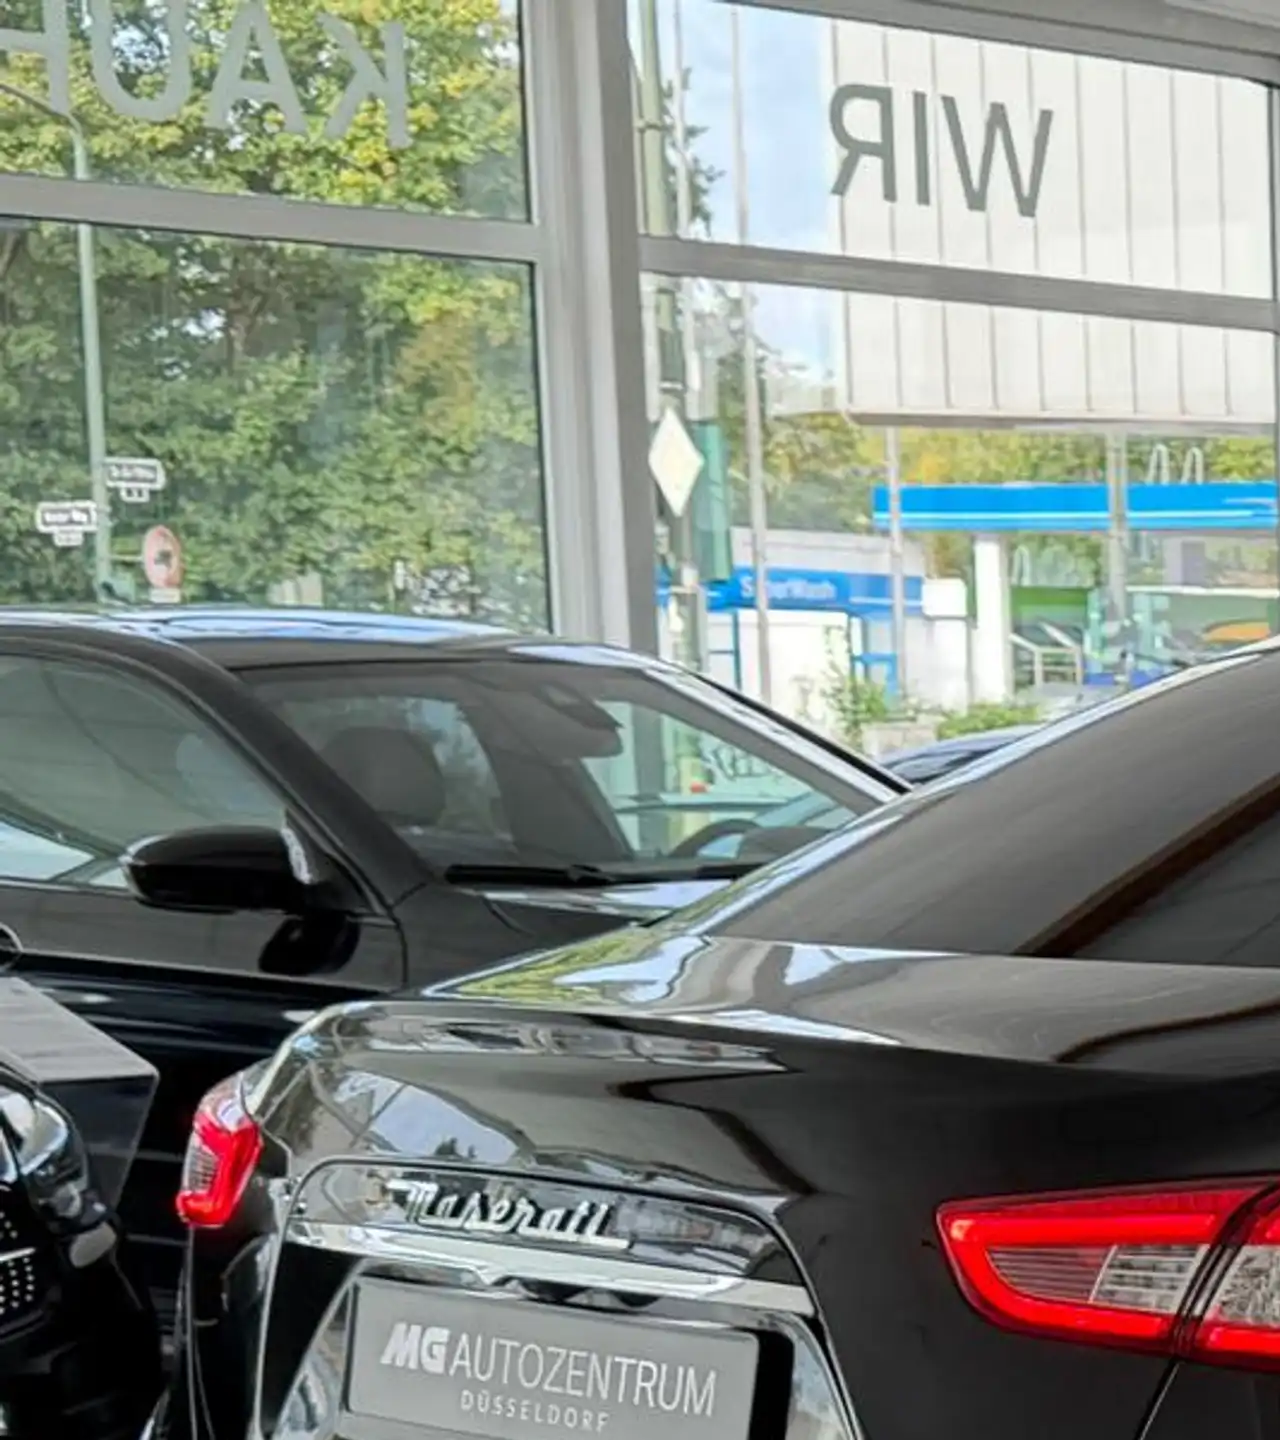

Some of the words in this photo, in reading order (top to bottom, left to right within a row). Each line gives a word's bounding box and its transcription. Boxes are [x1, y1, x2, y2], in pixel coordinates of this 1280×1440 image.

[387, 1177, 630, 1250] Maserati
[380, 1323, 450, 1374] MG
[449, 1333, 717, 1417] AUTOZENTRUM
[460, 1388, 610, 1433] DÜSSELDORF
